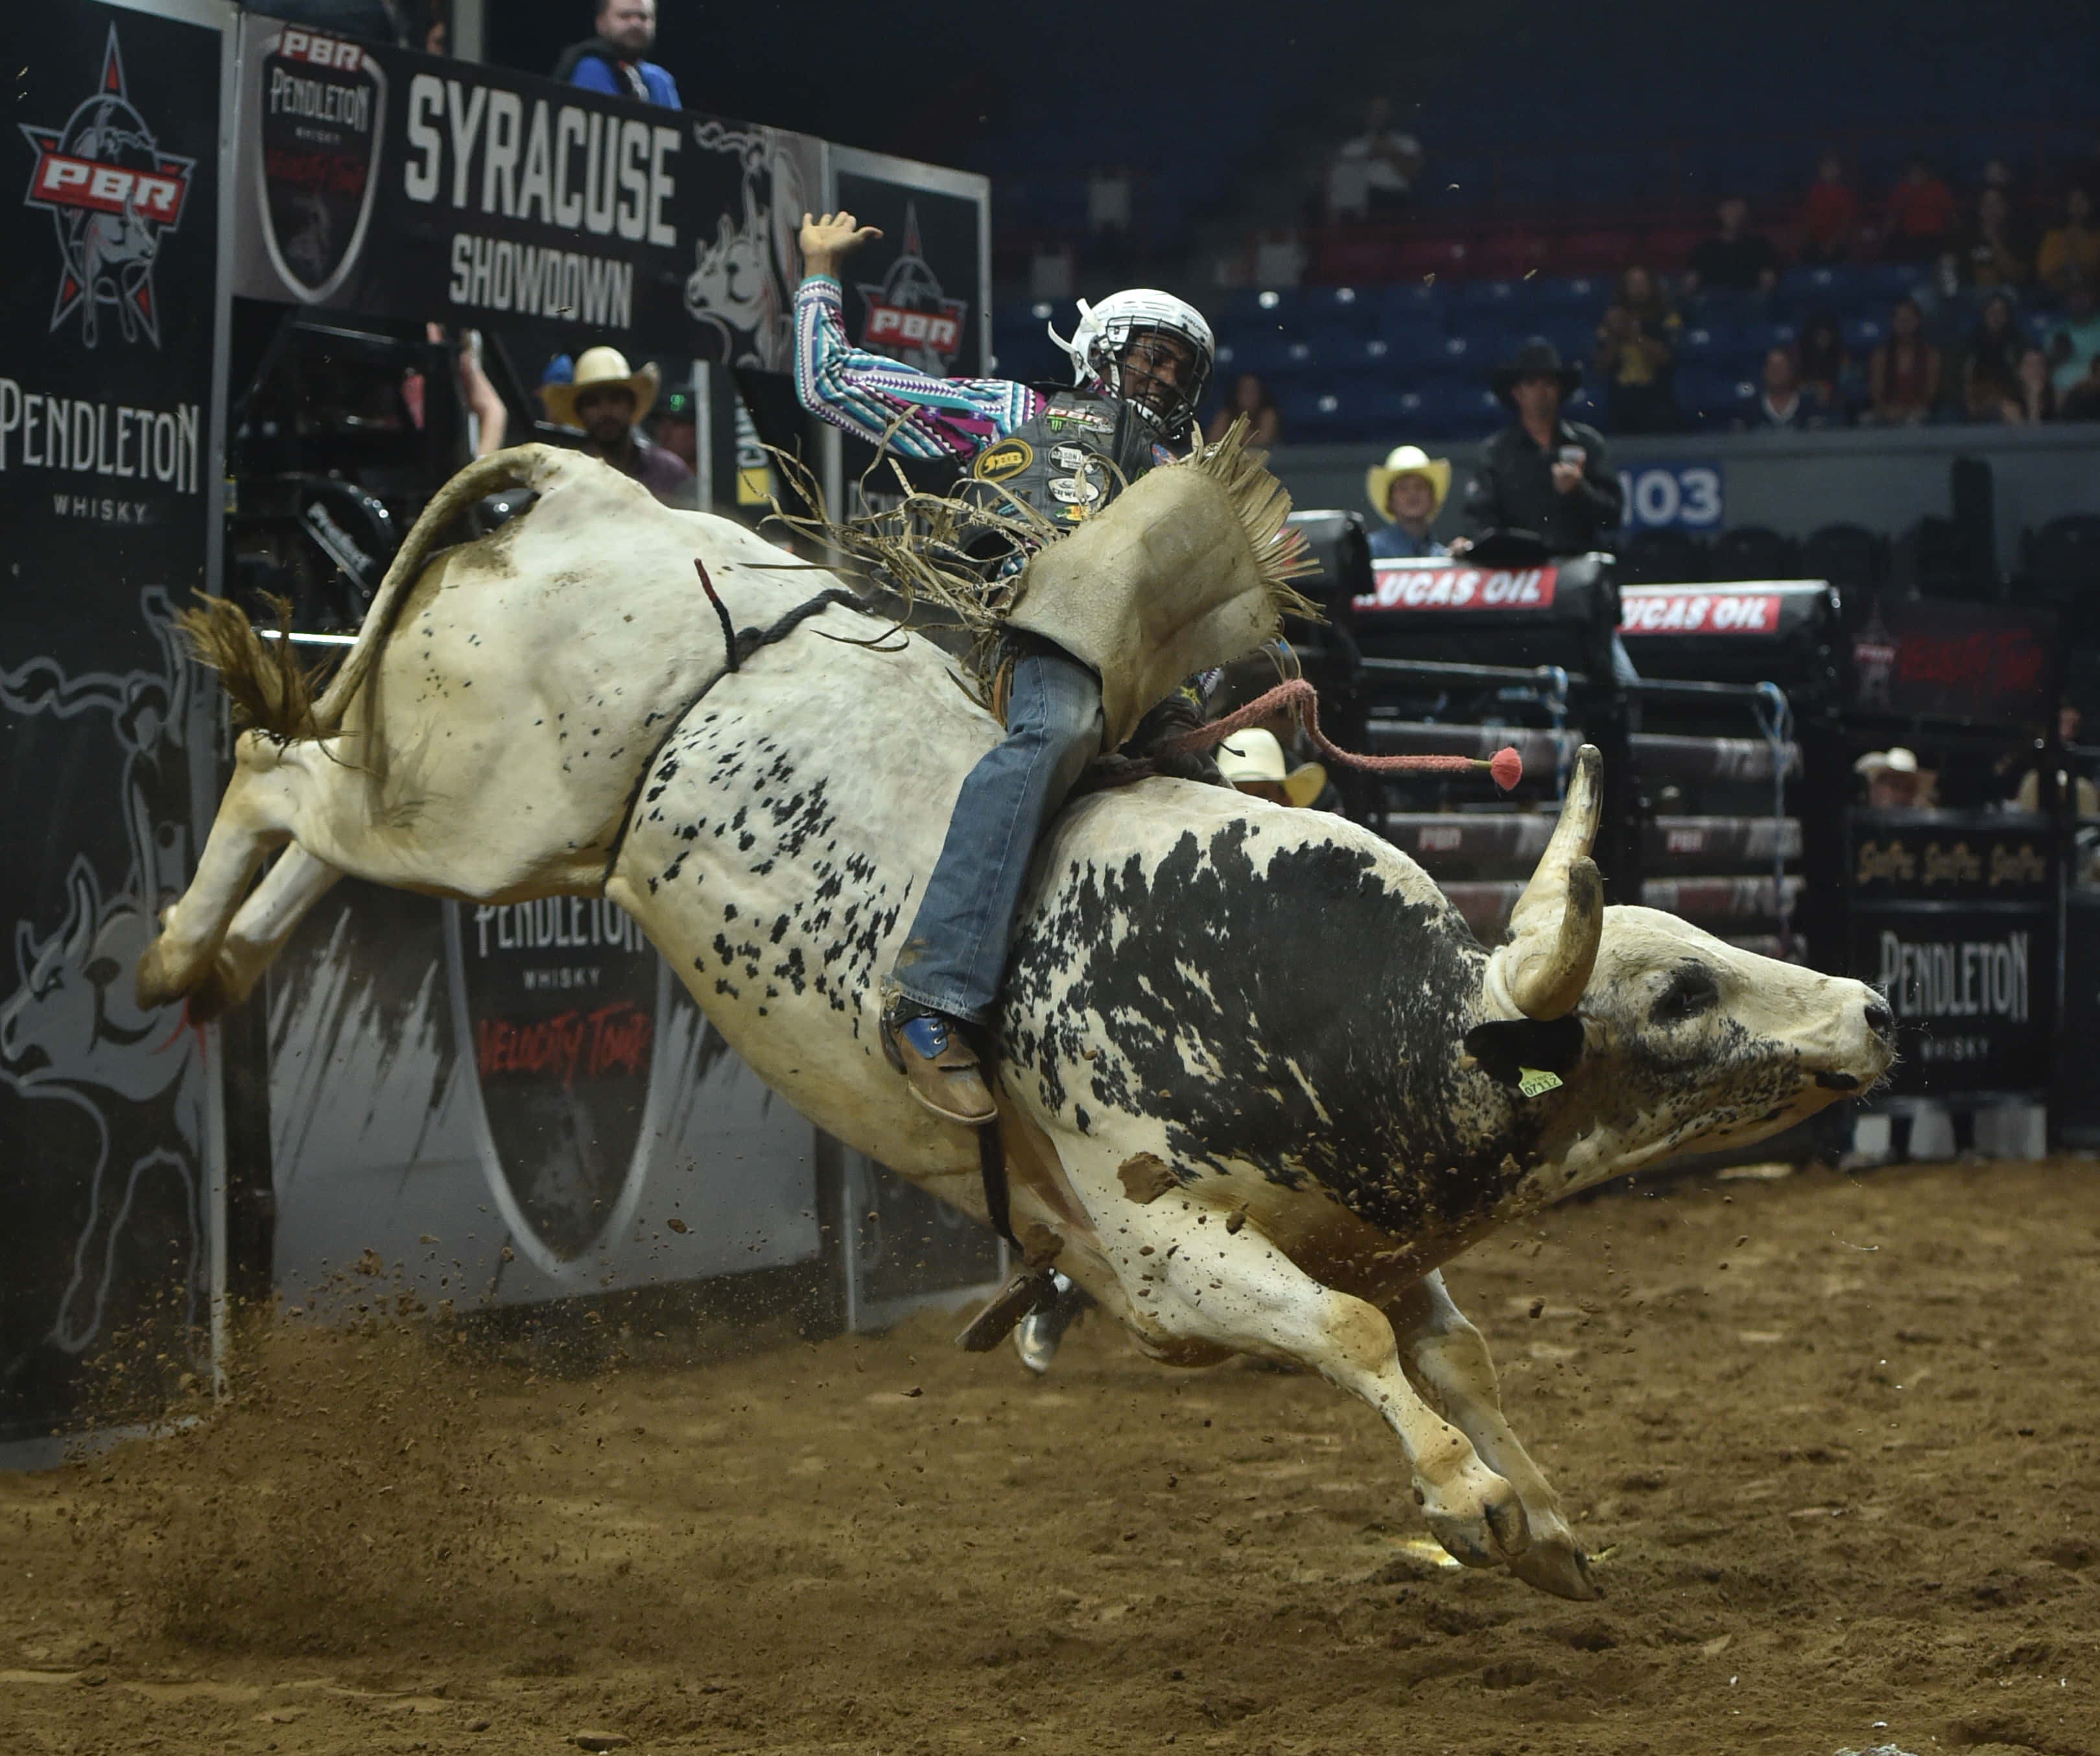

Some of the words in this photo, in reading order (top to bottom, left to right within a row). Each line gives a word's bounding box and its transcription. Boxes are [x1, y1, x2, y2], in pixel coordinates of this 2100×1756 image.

[280, 30, 362, 72] PBR
[270, 66, 370, 132] PENDLETON
[42, 158, 177, 211] PBR
[404, 73, 681, 248] SYRACUSE
[449, 233, 633, 329] SHOWDOWN
[872, 307, 956, 345] PBR
[0, 377, 200, 495] PENDLETON
[53, 493, 148, 524] WHISKY
[1618, 468, 1722, 526] 103
[1354, 570, 1480, 606] UCAS
[1483, 569, 1542, 604] OIL
[1622, 596, 1711, 630] UCAS
[1712, 595, 1767, 629] OIL
[522, 966, 600, 989] WHISKY
[1880, 930, 2029, 1023] PENDLETON
